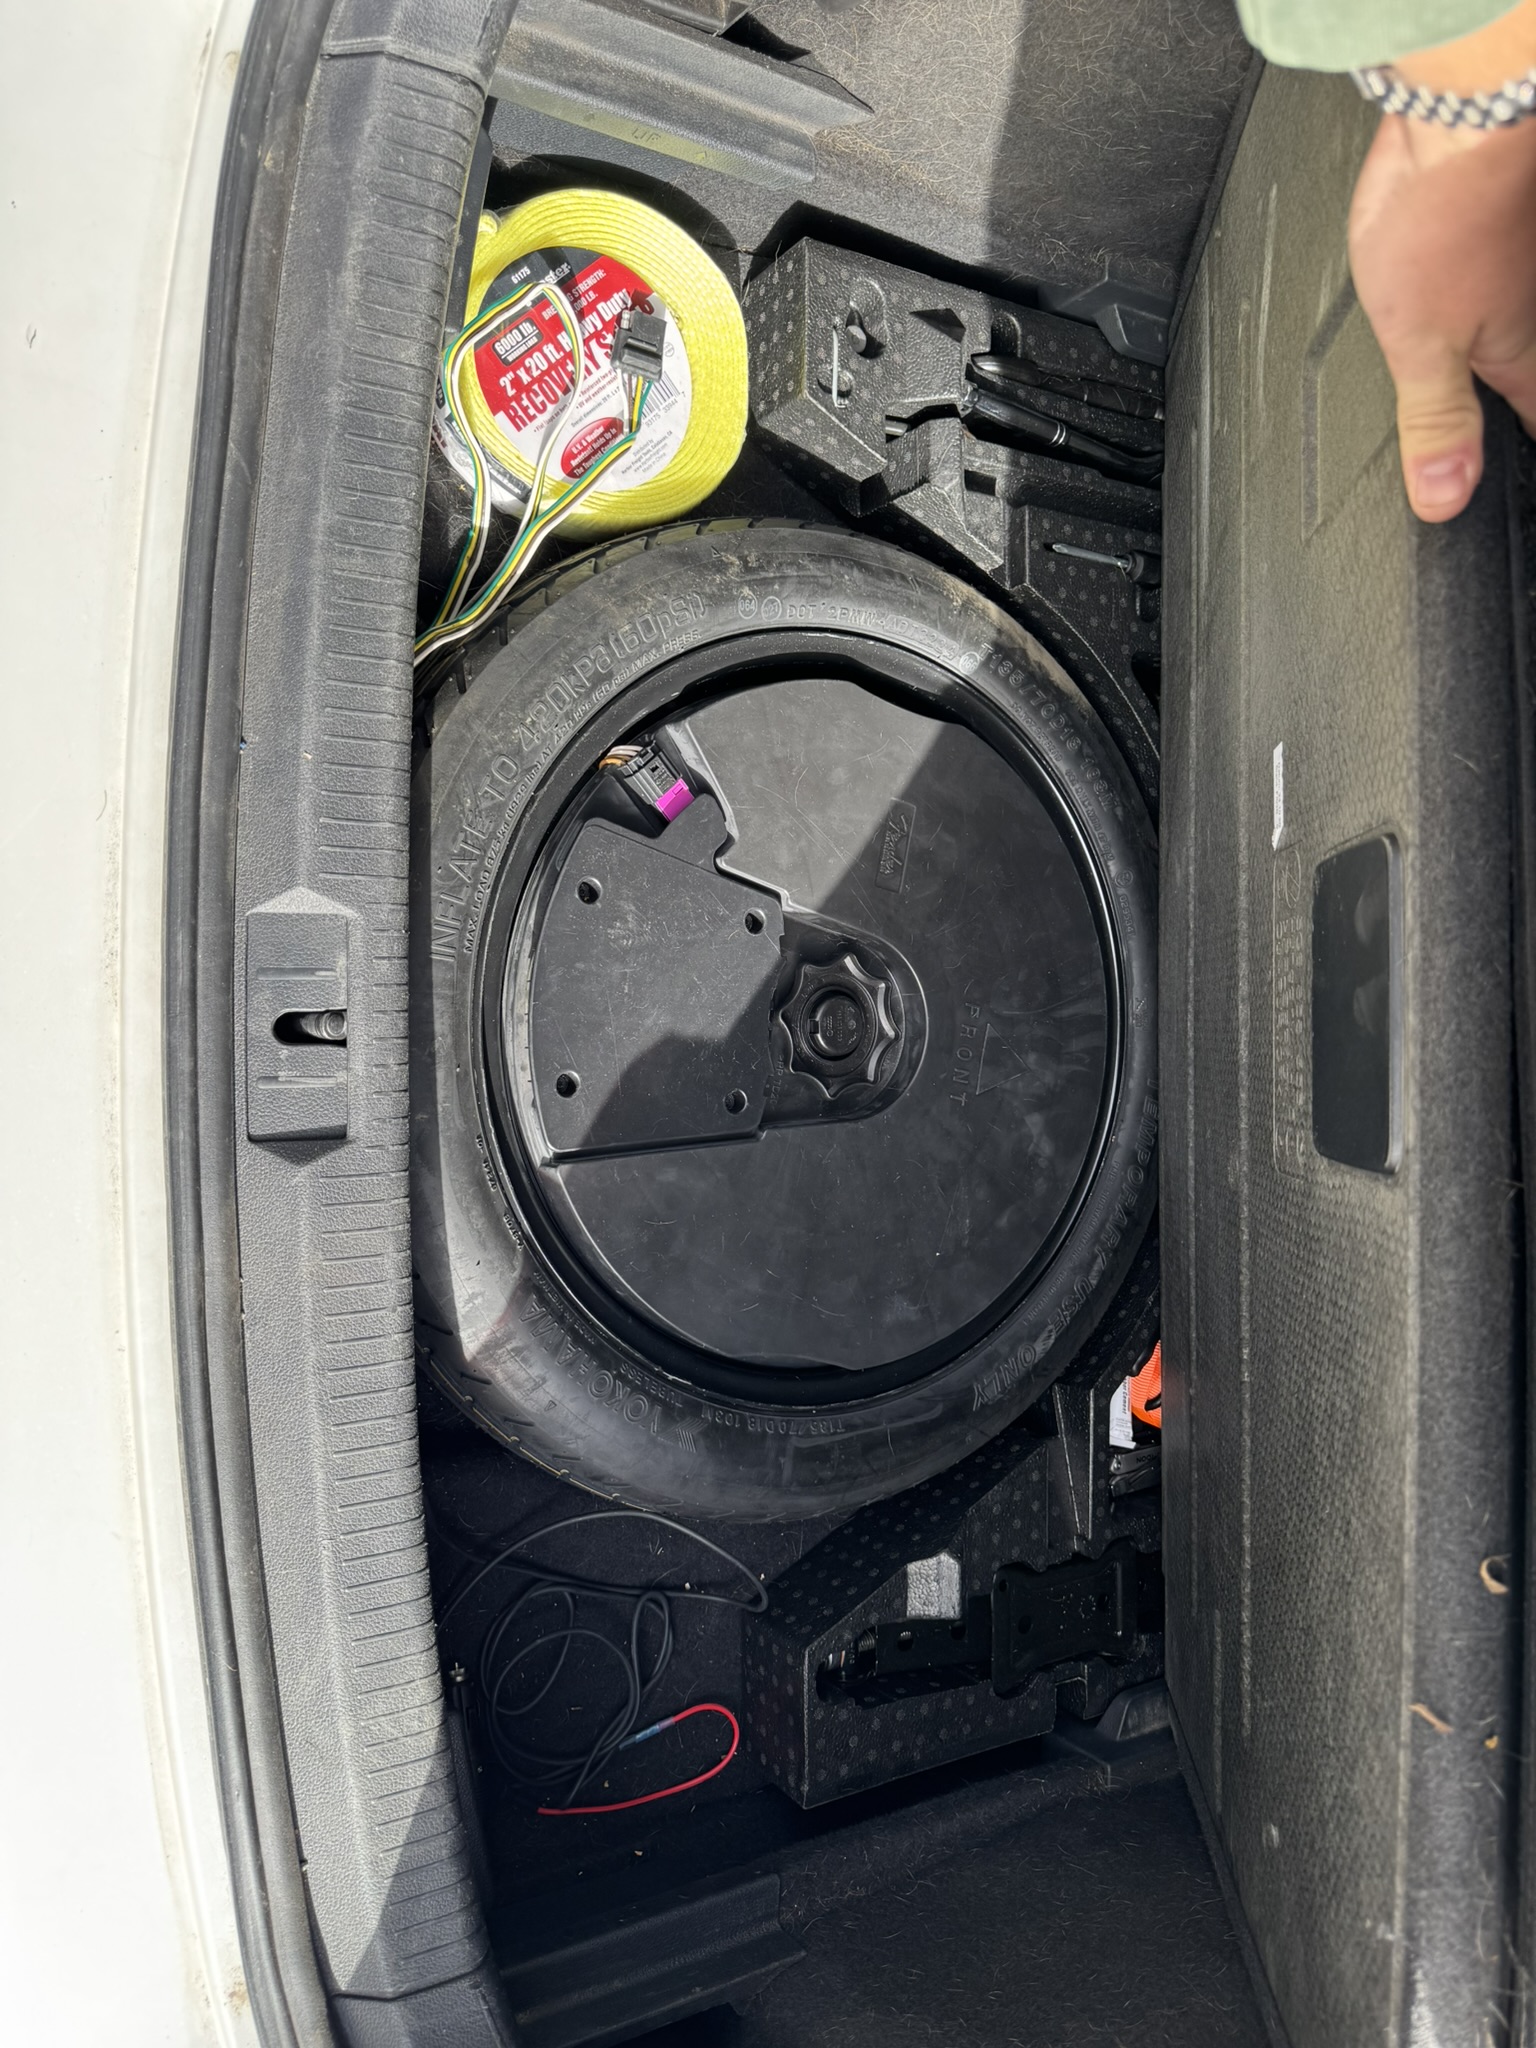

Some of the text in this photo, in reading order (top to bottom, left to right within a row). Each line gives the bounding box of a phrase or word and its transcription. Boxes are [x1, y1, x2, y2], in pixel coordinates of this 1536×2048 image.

[510, 265, 531, 284] 61175
[541, 267, 606, 320] BREG STRENGTH:
[585, 289, 598, 302] LB.
[493, 318, 536, 355] 6000 lb.
[506, 335, 538, 362] WORKING LOAD
[523, 349, 550, 377] 20
[541, 339, 564, 364] ft.
[556, 309, 604, 353] Havy
[595, 285, 634, 322] Duty
[644, 412, 661, 428] 93175
[661, 397, 679, 413] 33944
[584, 424, 605, 443] Weather
[573, 465, 584, 476] The
[641, 462, 653, 473] Made
[654, 451, 666, 462] China
[786, 603, 817, 620] DOT
[465, 915, 478, 953] MAX.
[472, 870, 490, 911] LOAD
[540, 745, 554, 763] AT
[631, 648, 660, 673] MAX.
[662, 629, 701, 655] PRESS.
[428, 805, 493, 962] INFLATE
[476, 748, 522, 809] TO
[884, 813, 909, 875] Fender
[949, 1001, 980, 1107] FRONT
[963, 1076, 1164, 1414] TEMPORARY USE ONLY
[512, 1290, 665, 1437] YOKOHAMA
[617, 1359, 685, 1408] TUBELESS
[1120, 1391, 1128, 1414] Cement
